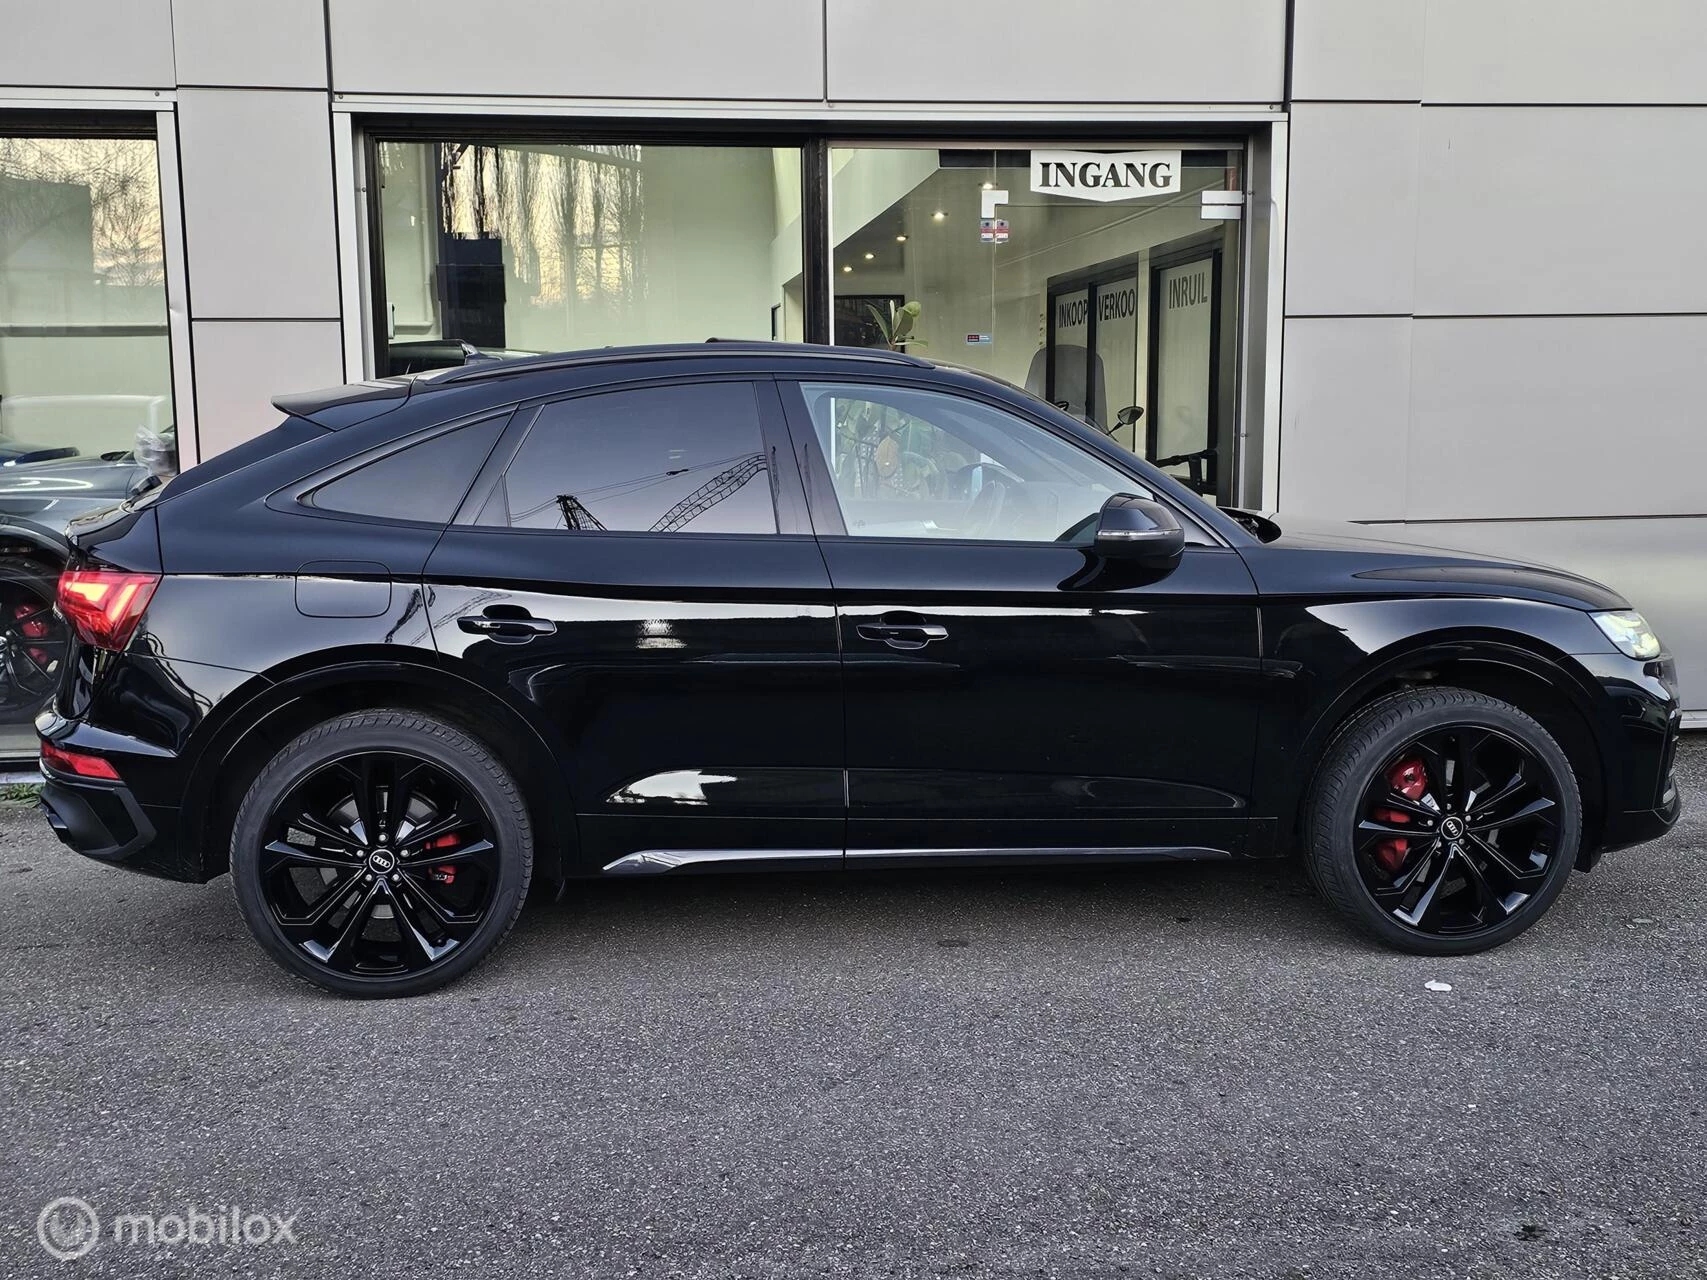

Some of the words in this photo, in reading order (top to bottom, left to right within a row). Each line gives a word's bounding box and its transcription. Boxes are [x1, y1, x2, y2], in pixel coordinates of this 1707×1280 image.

[1039, 162, 1172, 188] INGANG
[1168, 272, 1208, 309] INRUIL
[1058, 299, 1088, 328] INKOOP
